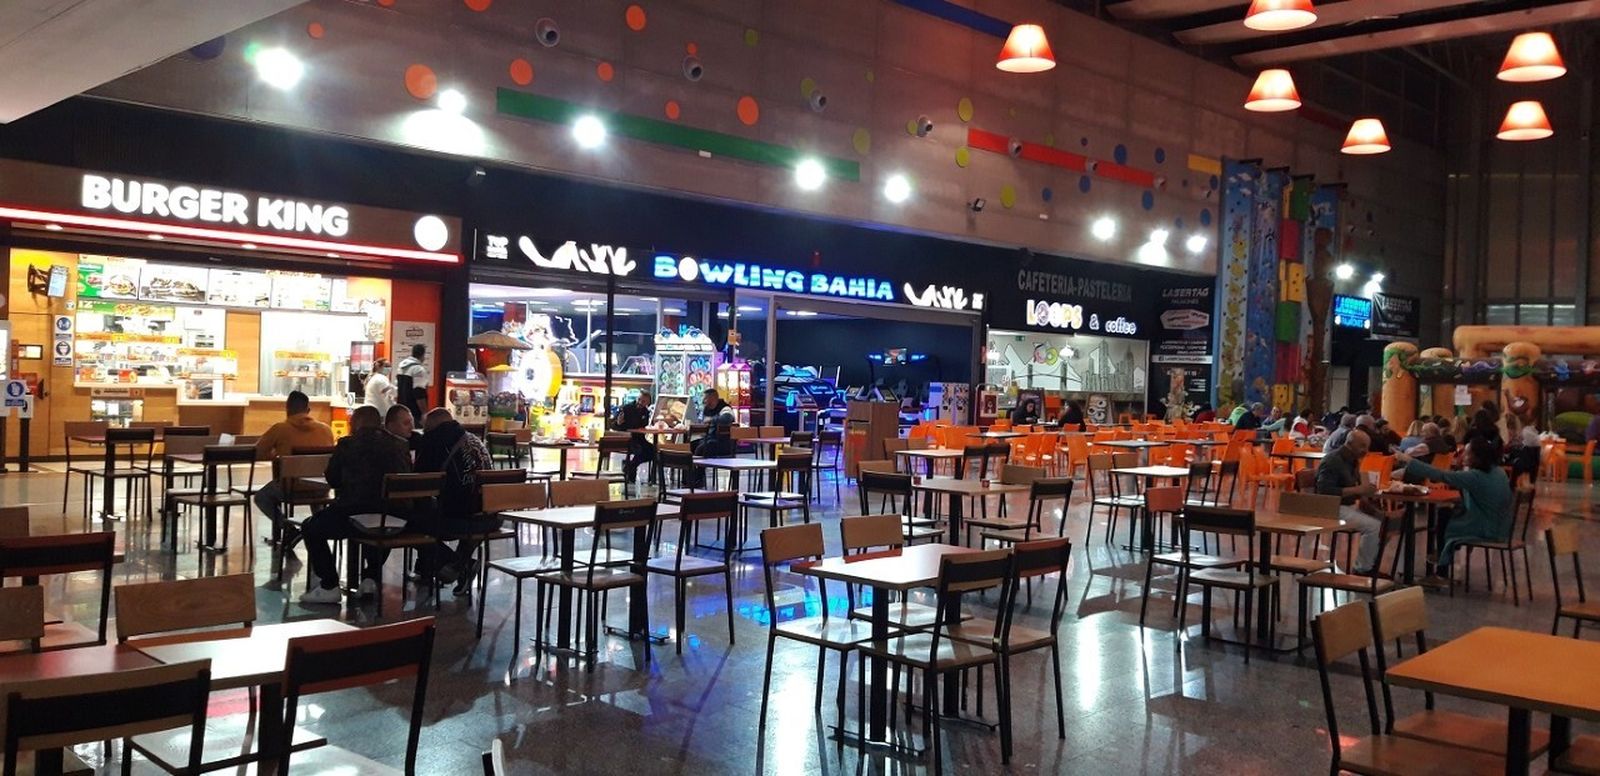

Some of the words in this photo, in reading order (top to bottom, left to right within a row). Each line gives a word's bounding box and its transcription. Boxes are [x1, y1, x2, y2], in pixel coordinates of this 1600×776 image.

[82, 174, 249, 226] BURGER
[257, 197, 349, 237] KING
[654, 256, 804, 293] BOWLING
[811, 273, 894, 300] BAHIA
[1018, 270, 1132, 302] CAFETERIA-PASTELERIA
[1162, 287, 1210, 298] LASERTAG
[1026, 299, 1082, 329] LOOPS
[1089, 313, 1099, 330] &
[1105, 316, 1137, 334] coffee
